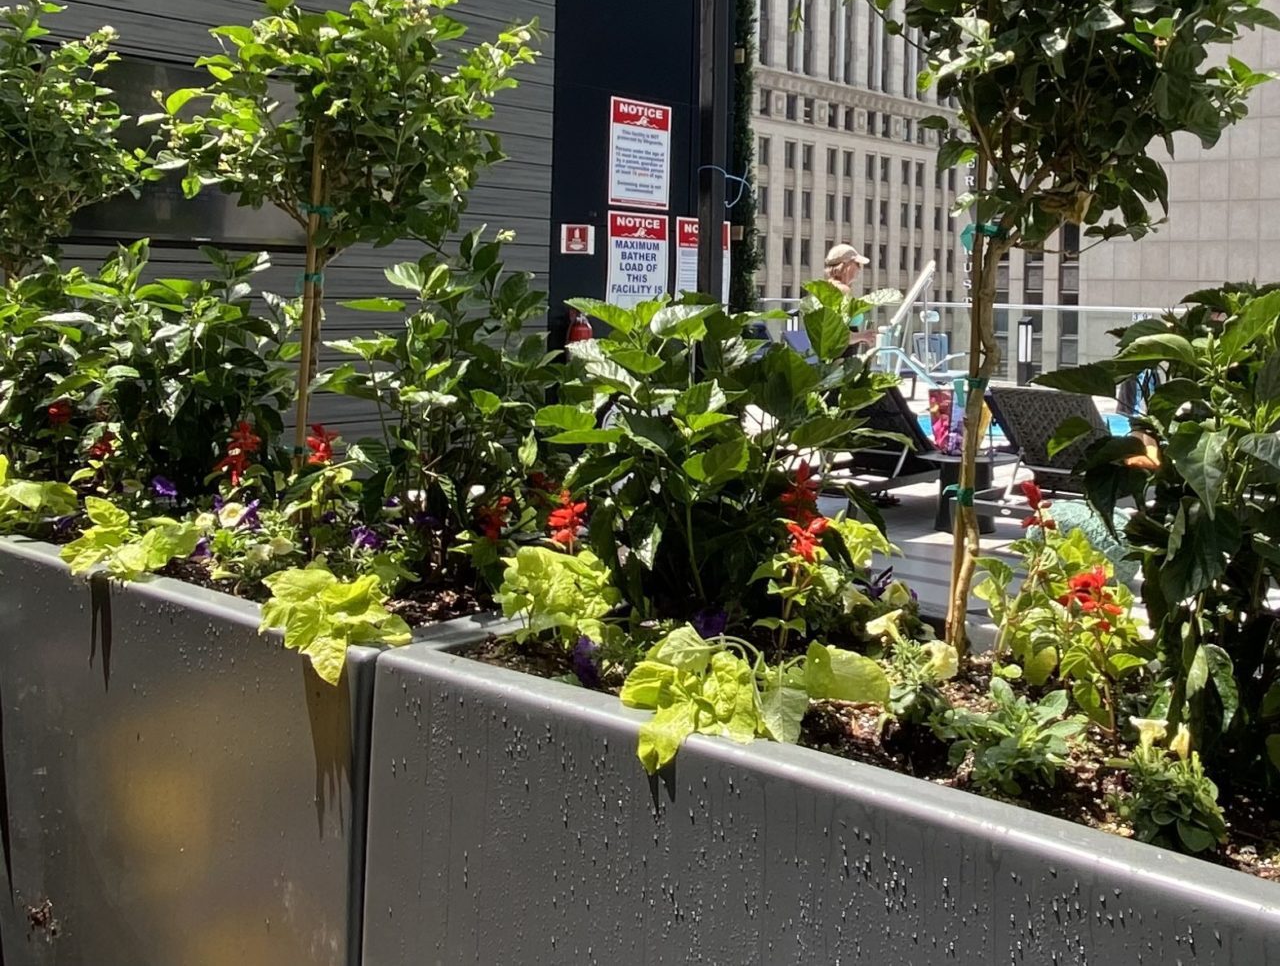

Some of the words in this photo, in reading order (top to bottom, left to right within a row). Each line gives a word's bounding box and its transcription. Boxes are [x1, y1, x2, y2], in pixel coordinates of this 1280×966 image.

[619, 103, 664, 120] NOTICE
[616, 216, 661, 229] NOTICE
[615, 240, 660, 250] MAXIMUM
[621, 251, 657, 262] BATHER
[619, 263, 644, 272] LOAD
[646, 264, 658, 272] OF
[627, 274, 648, 283] THIS
[611, 284, 652, 294] FACILITY
[654, 286, 663, 294] IS
